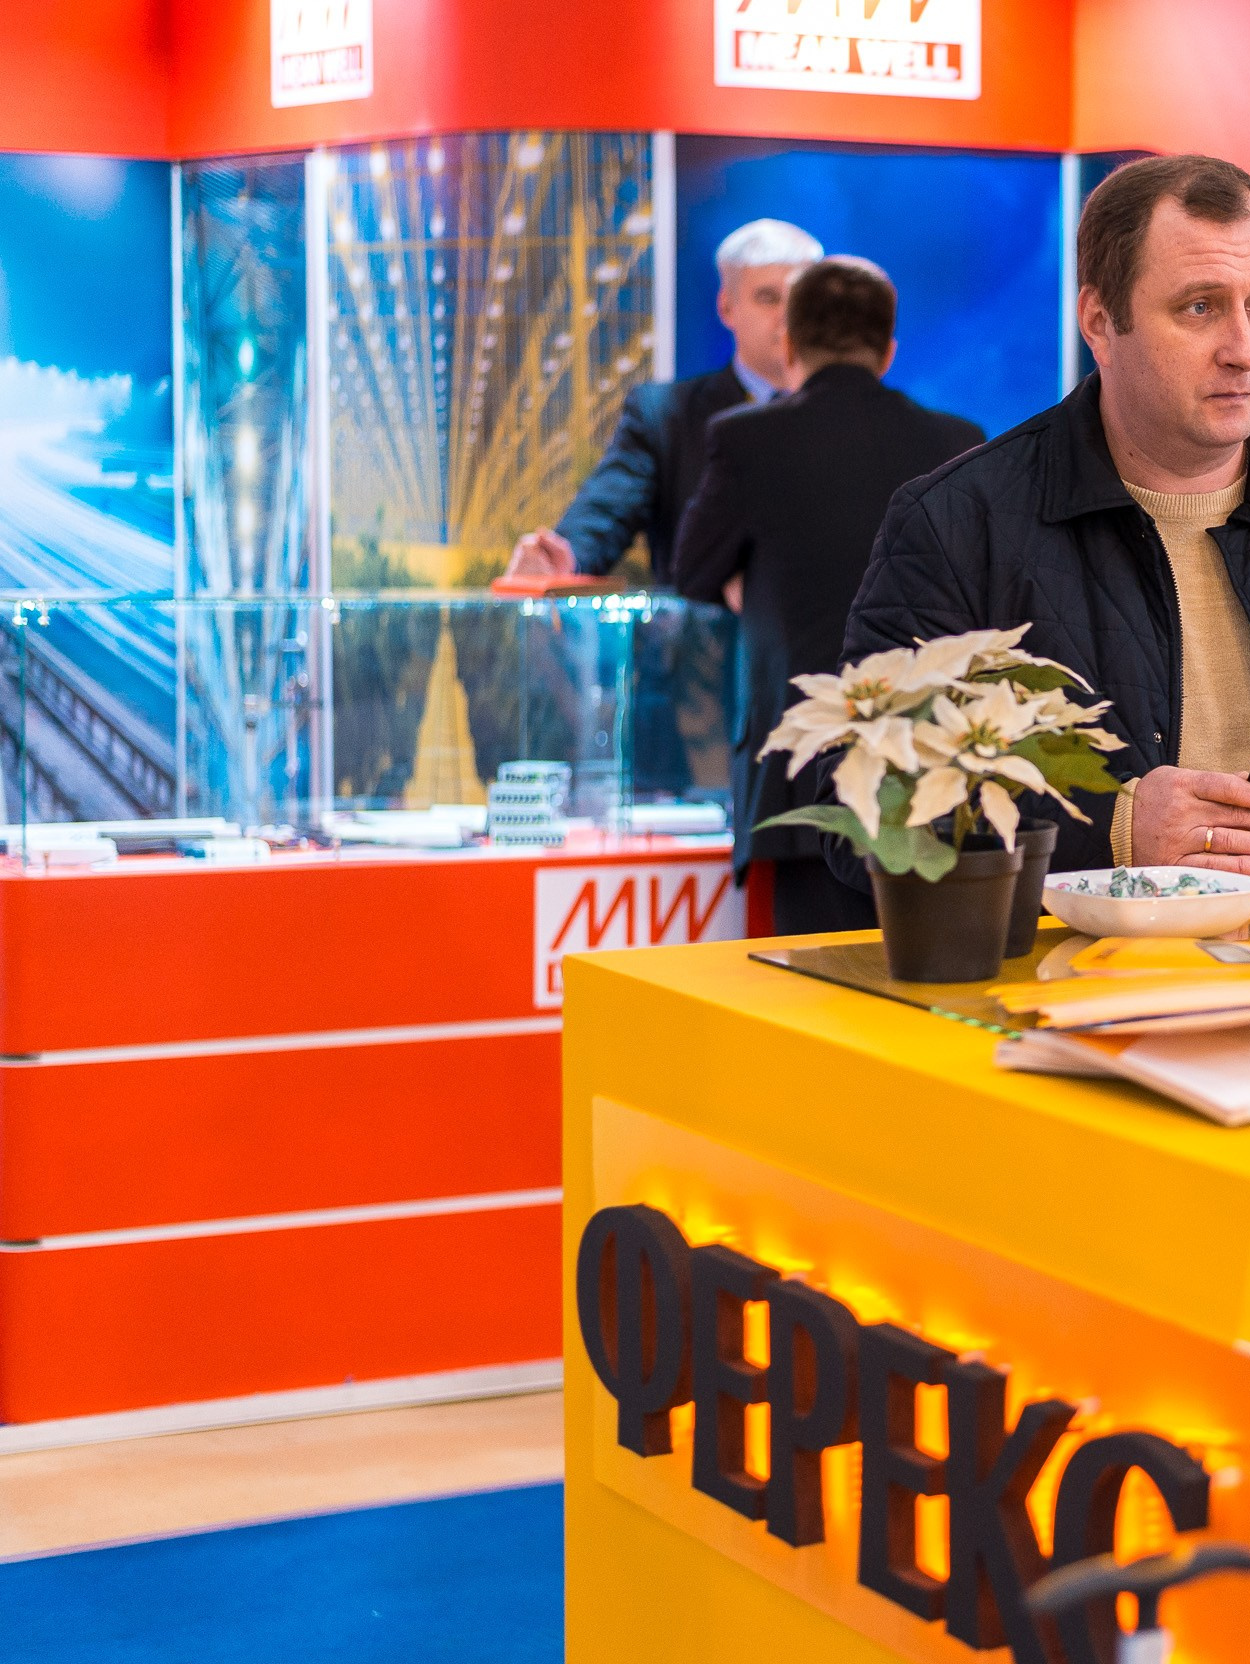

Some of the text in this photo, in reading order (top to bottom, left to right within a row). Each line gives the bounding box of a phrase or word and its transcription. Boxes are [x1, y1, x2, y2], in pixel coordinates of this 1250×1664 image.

[856, 39, 960, 80] WELL
[551, 872, 731, 949] MW
[577, 1203, 1212, 1664] ФЕРЕКС
